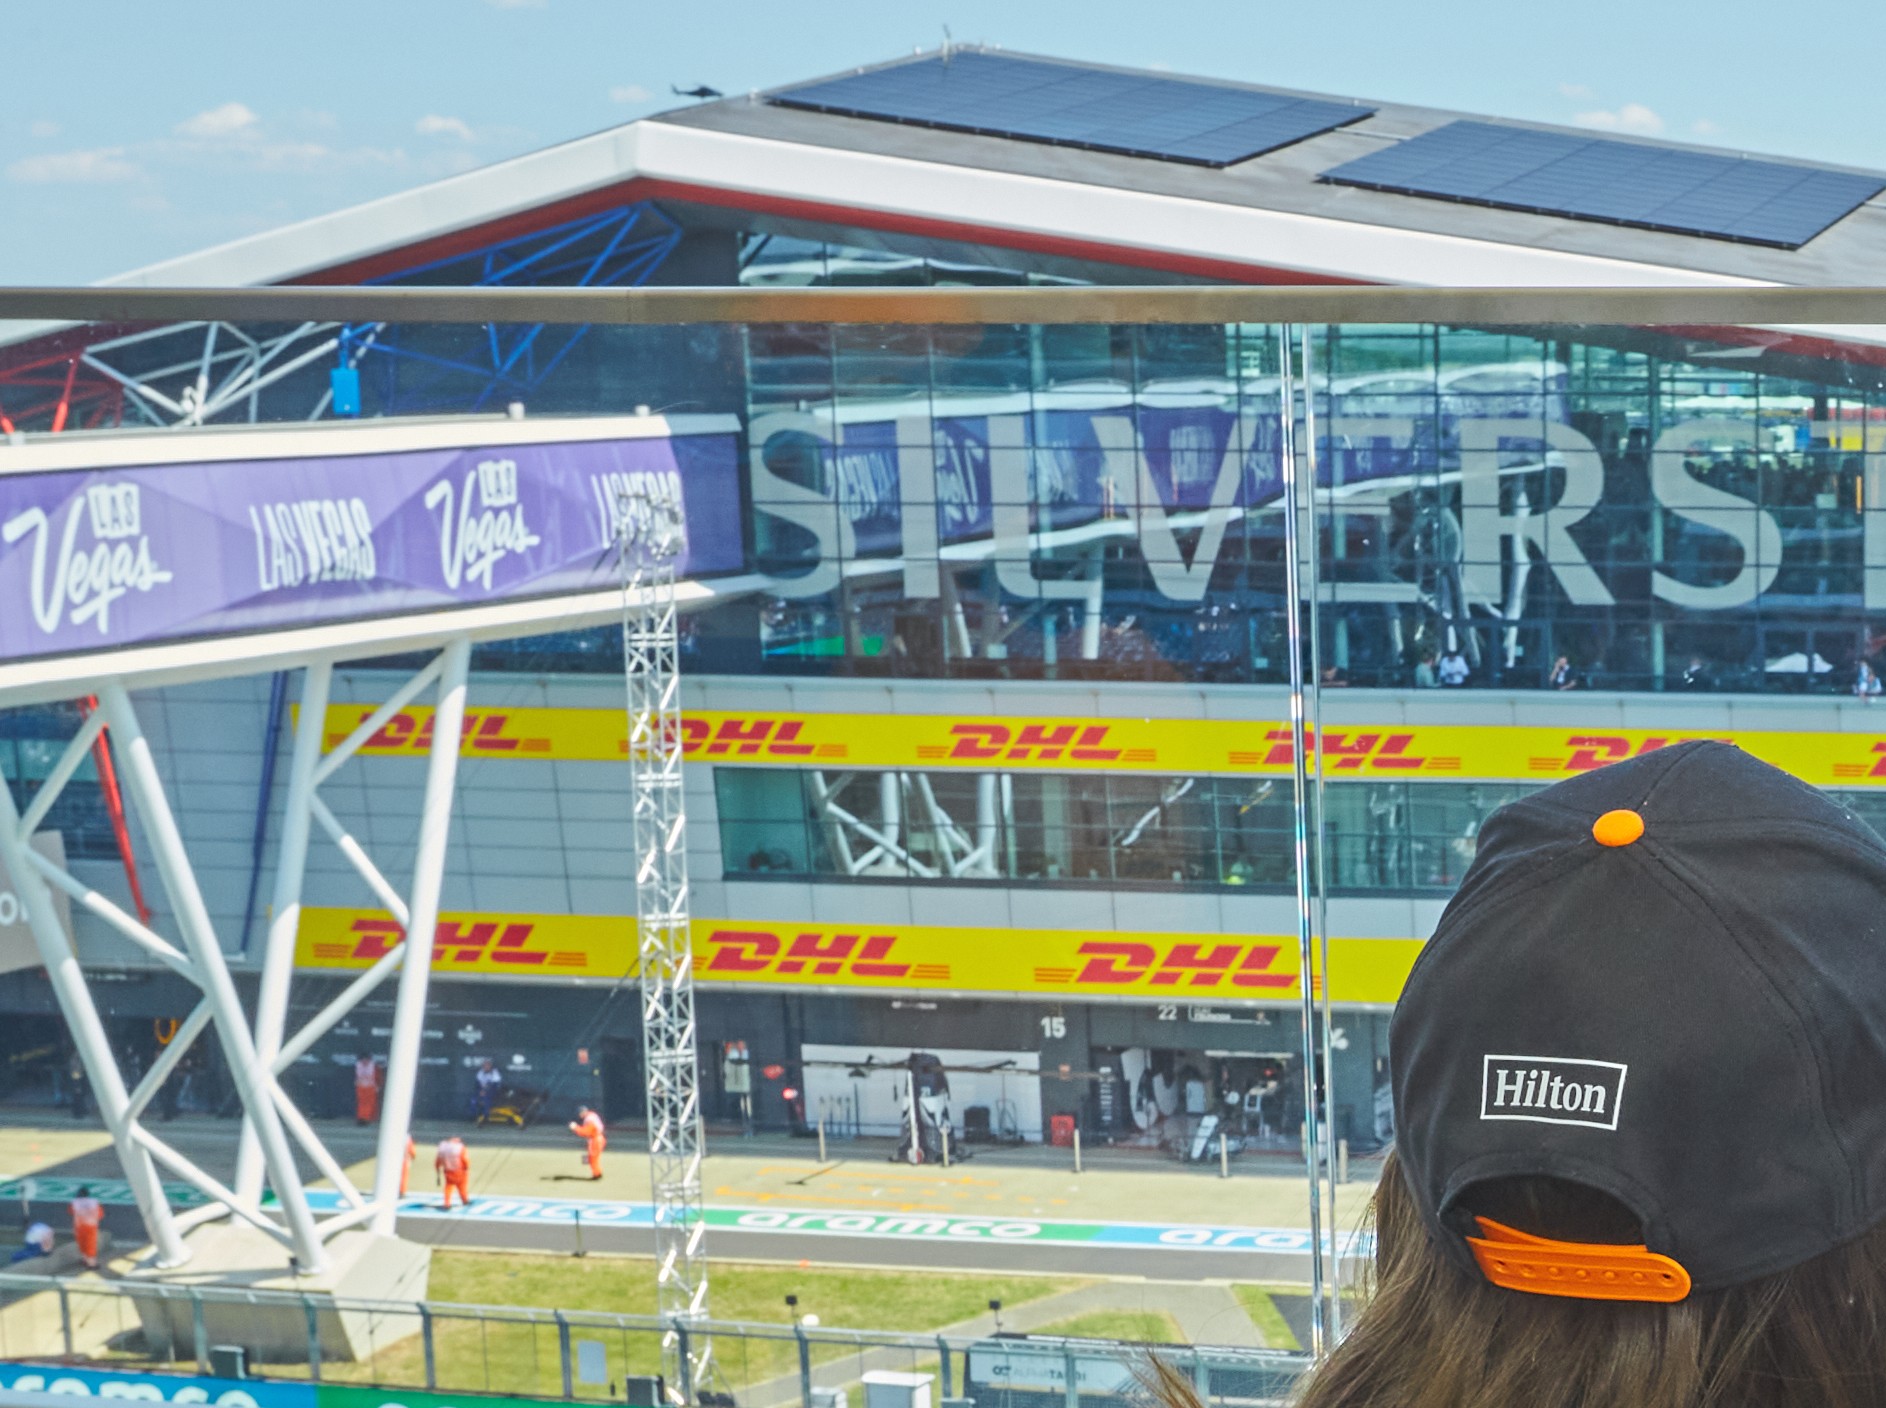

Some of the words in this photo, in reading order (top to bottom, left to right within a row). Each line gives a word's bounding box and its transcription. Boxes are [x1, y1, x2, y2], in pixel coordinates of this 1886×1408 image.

[90, 484, 138, 536] LAS
[425, 470, 541, 591] Vegas
[2, 496, 173, 634] Vegas
[250, 502, 304, 591] LAS
[292, 498, 376, 584] VEGAS
[354, 714, 519, 750] DHL
[650, 719, 815, 755] DHL
[948, 725, 1122, 760] DHL
[1263, 730, 1426, 769] DHL
[350, 920, 549, 964] DHL
[708, 931, 912, 977] DHL
[1076, 942, 1300, 988] DHL
[1041, 1017, 1066, 1038] 15
[1494, 1069, 1606, 1113] Hilton
[735, 1211, 1042, 1238] aramco
